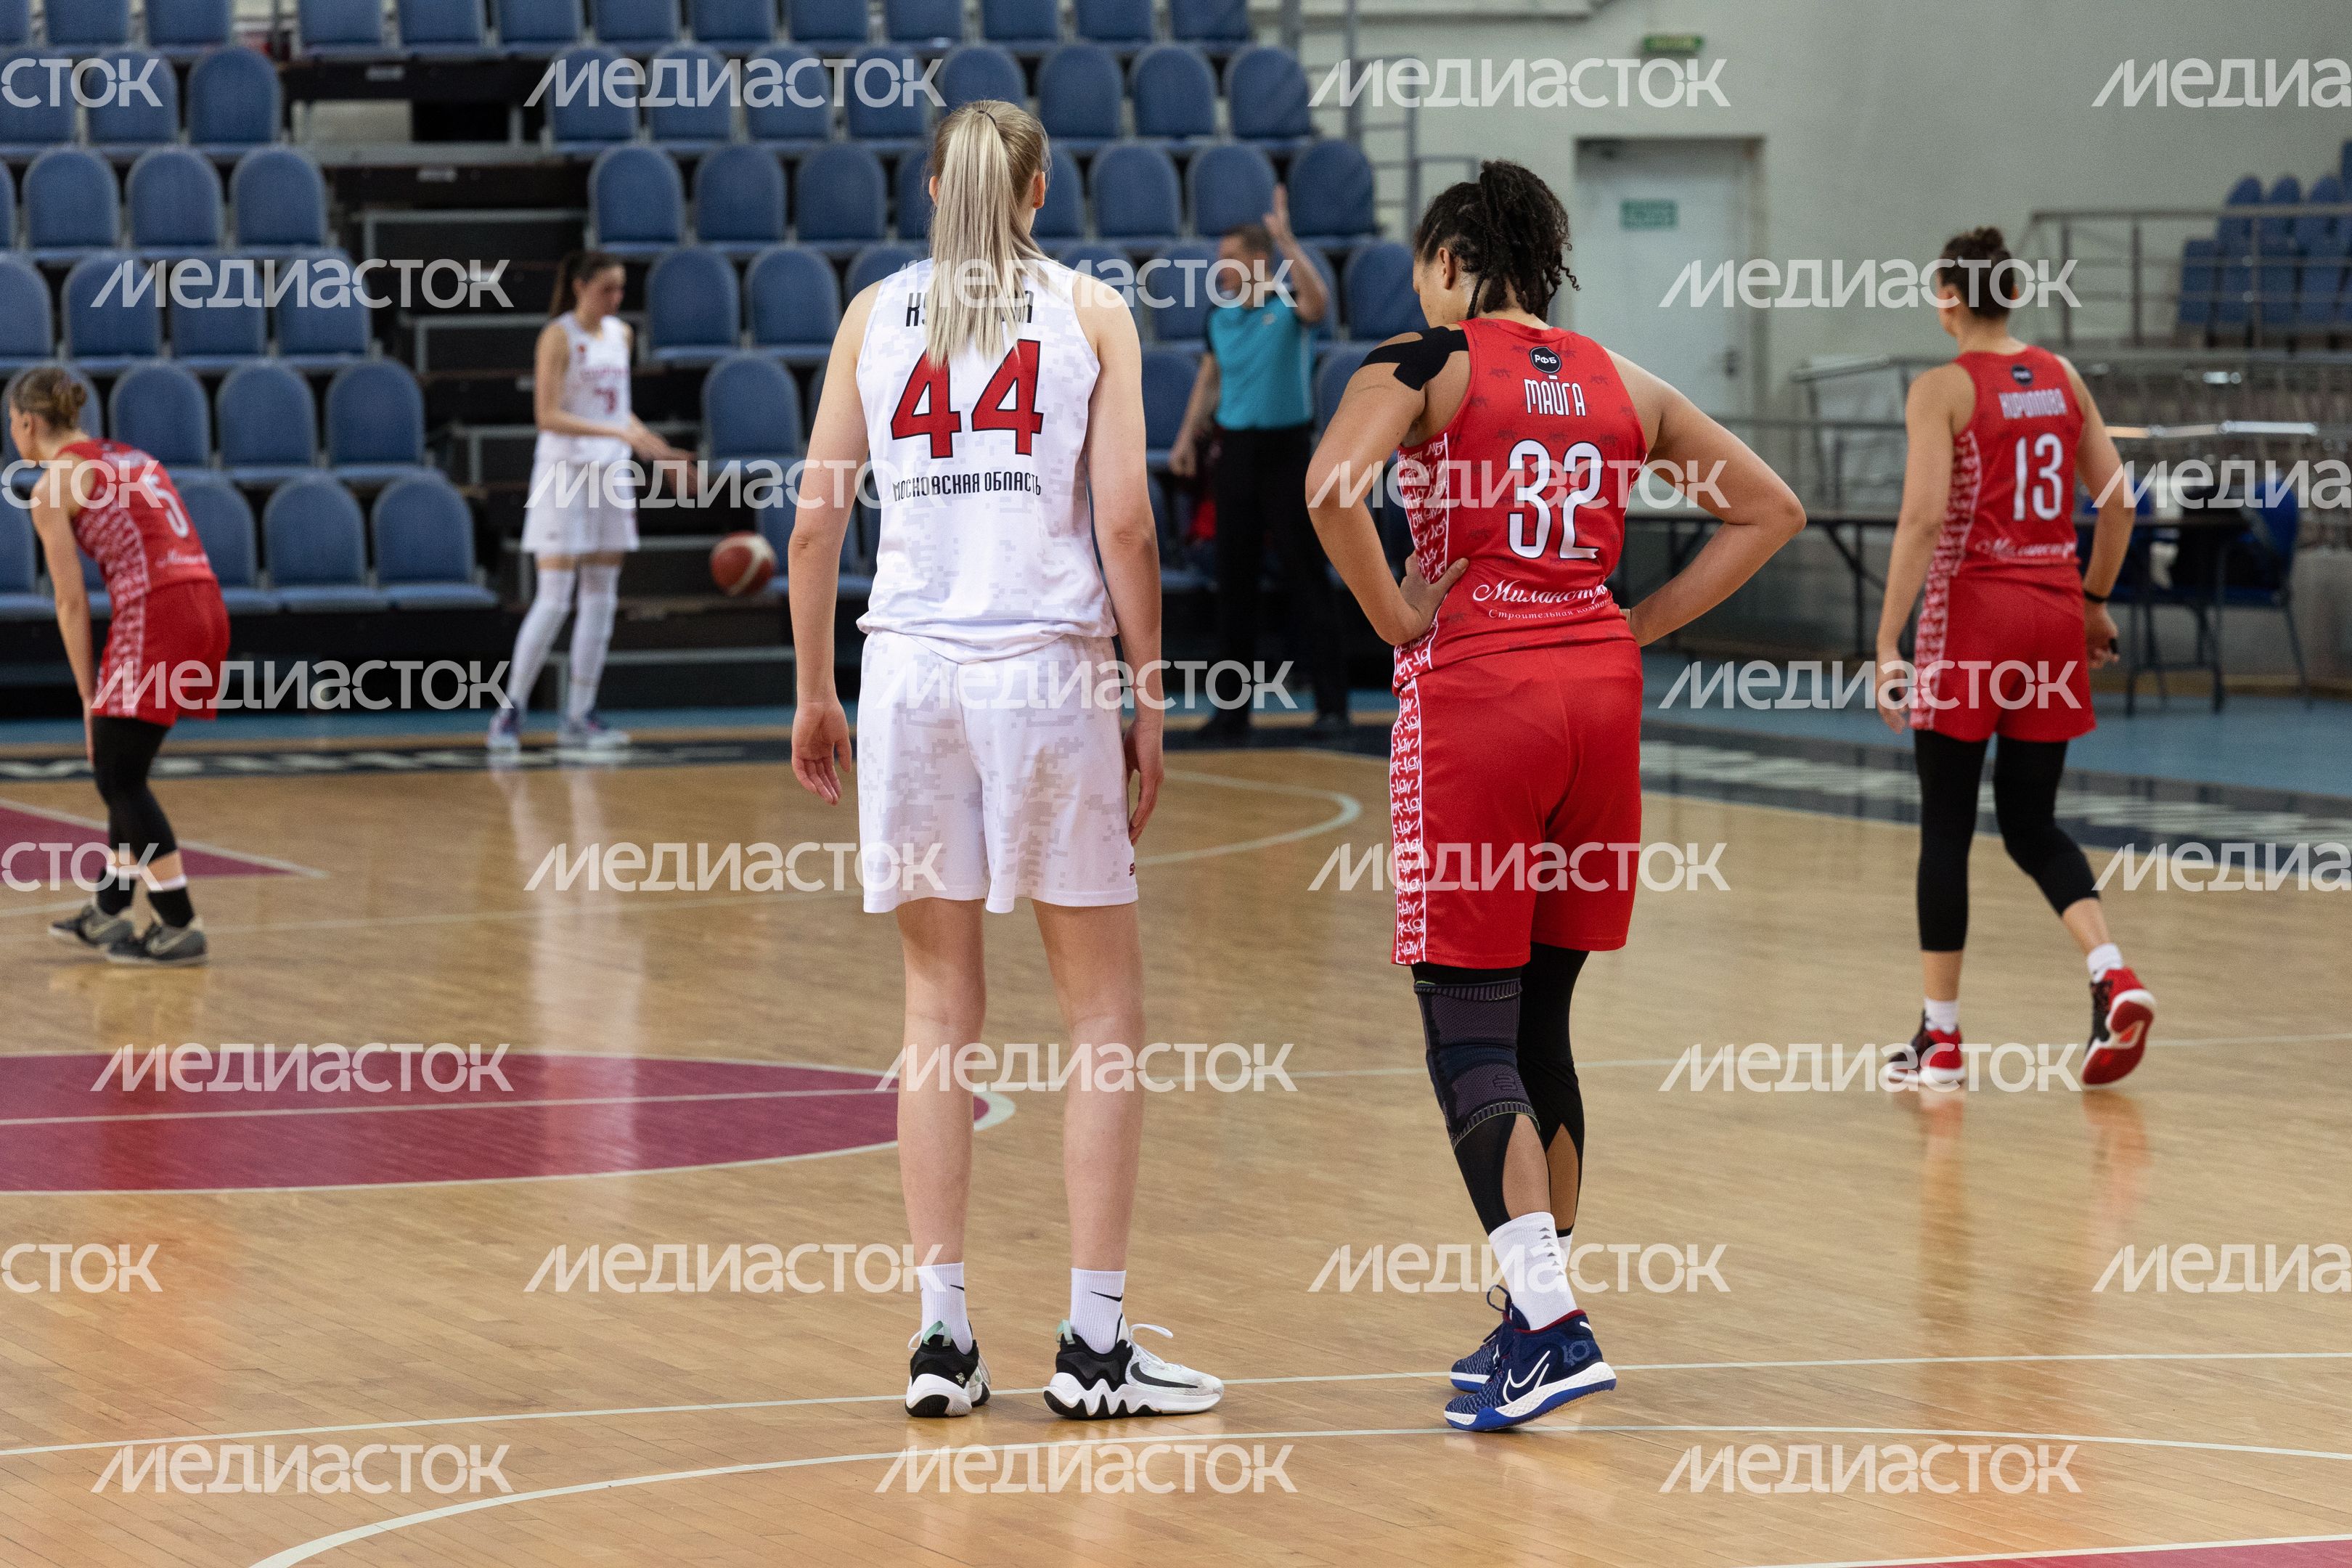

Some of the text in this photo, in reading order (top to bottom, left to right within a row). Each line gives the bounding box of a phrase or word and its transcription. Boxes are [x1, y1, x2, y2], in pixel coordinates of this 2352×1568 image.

[1534, 354, 1556, 364] РФБ
[890, 338, 1044, 459] 44
[1524, 375, 1586, 417] МАЙГА
[892, 471, 1042, 502] МОСКОВСКАЯ ОБЛАСТЬ
[1507, 438, 1603, 560] 32
[2013, 433, 2063, 521] 13
